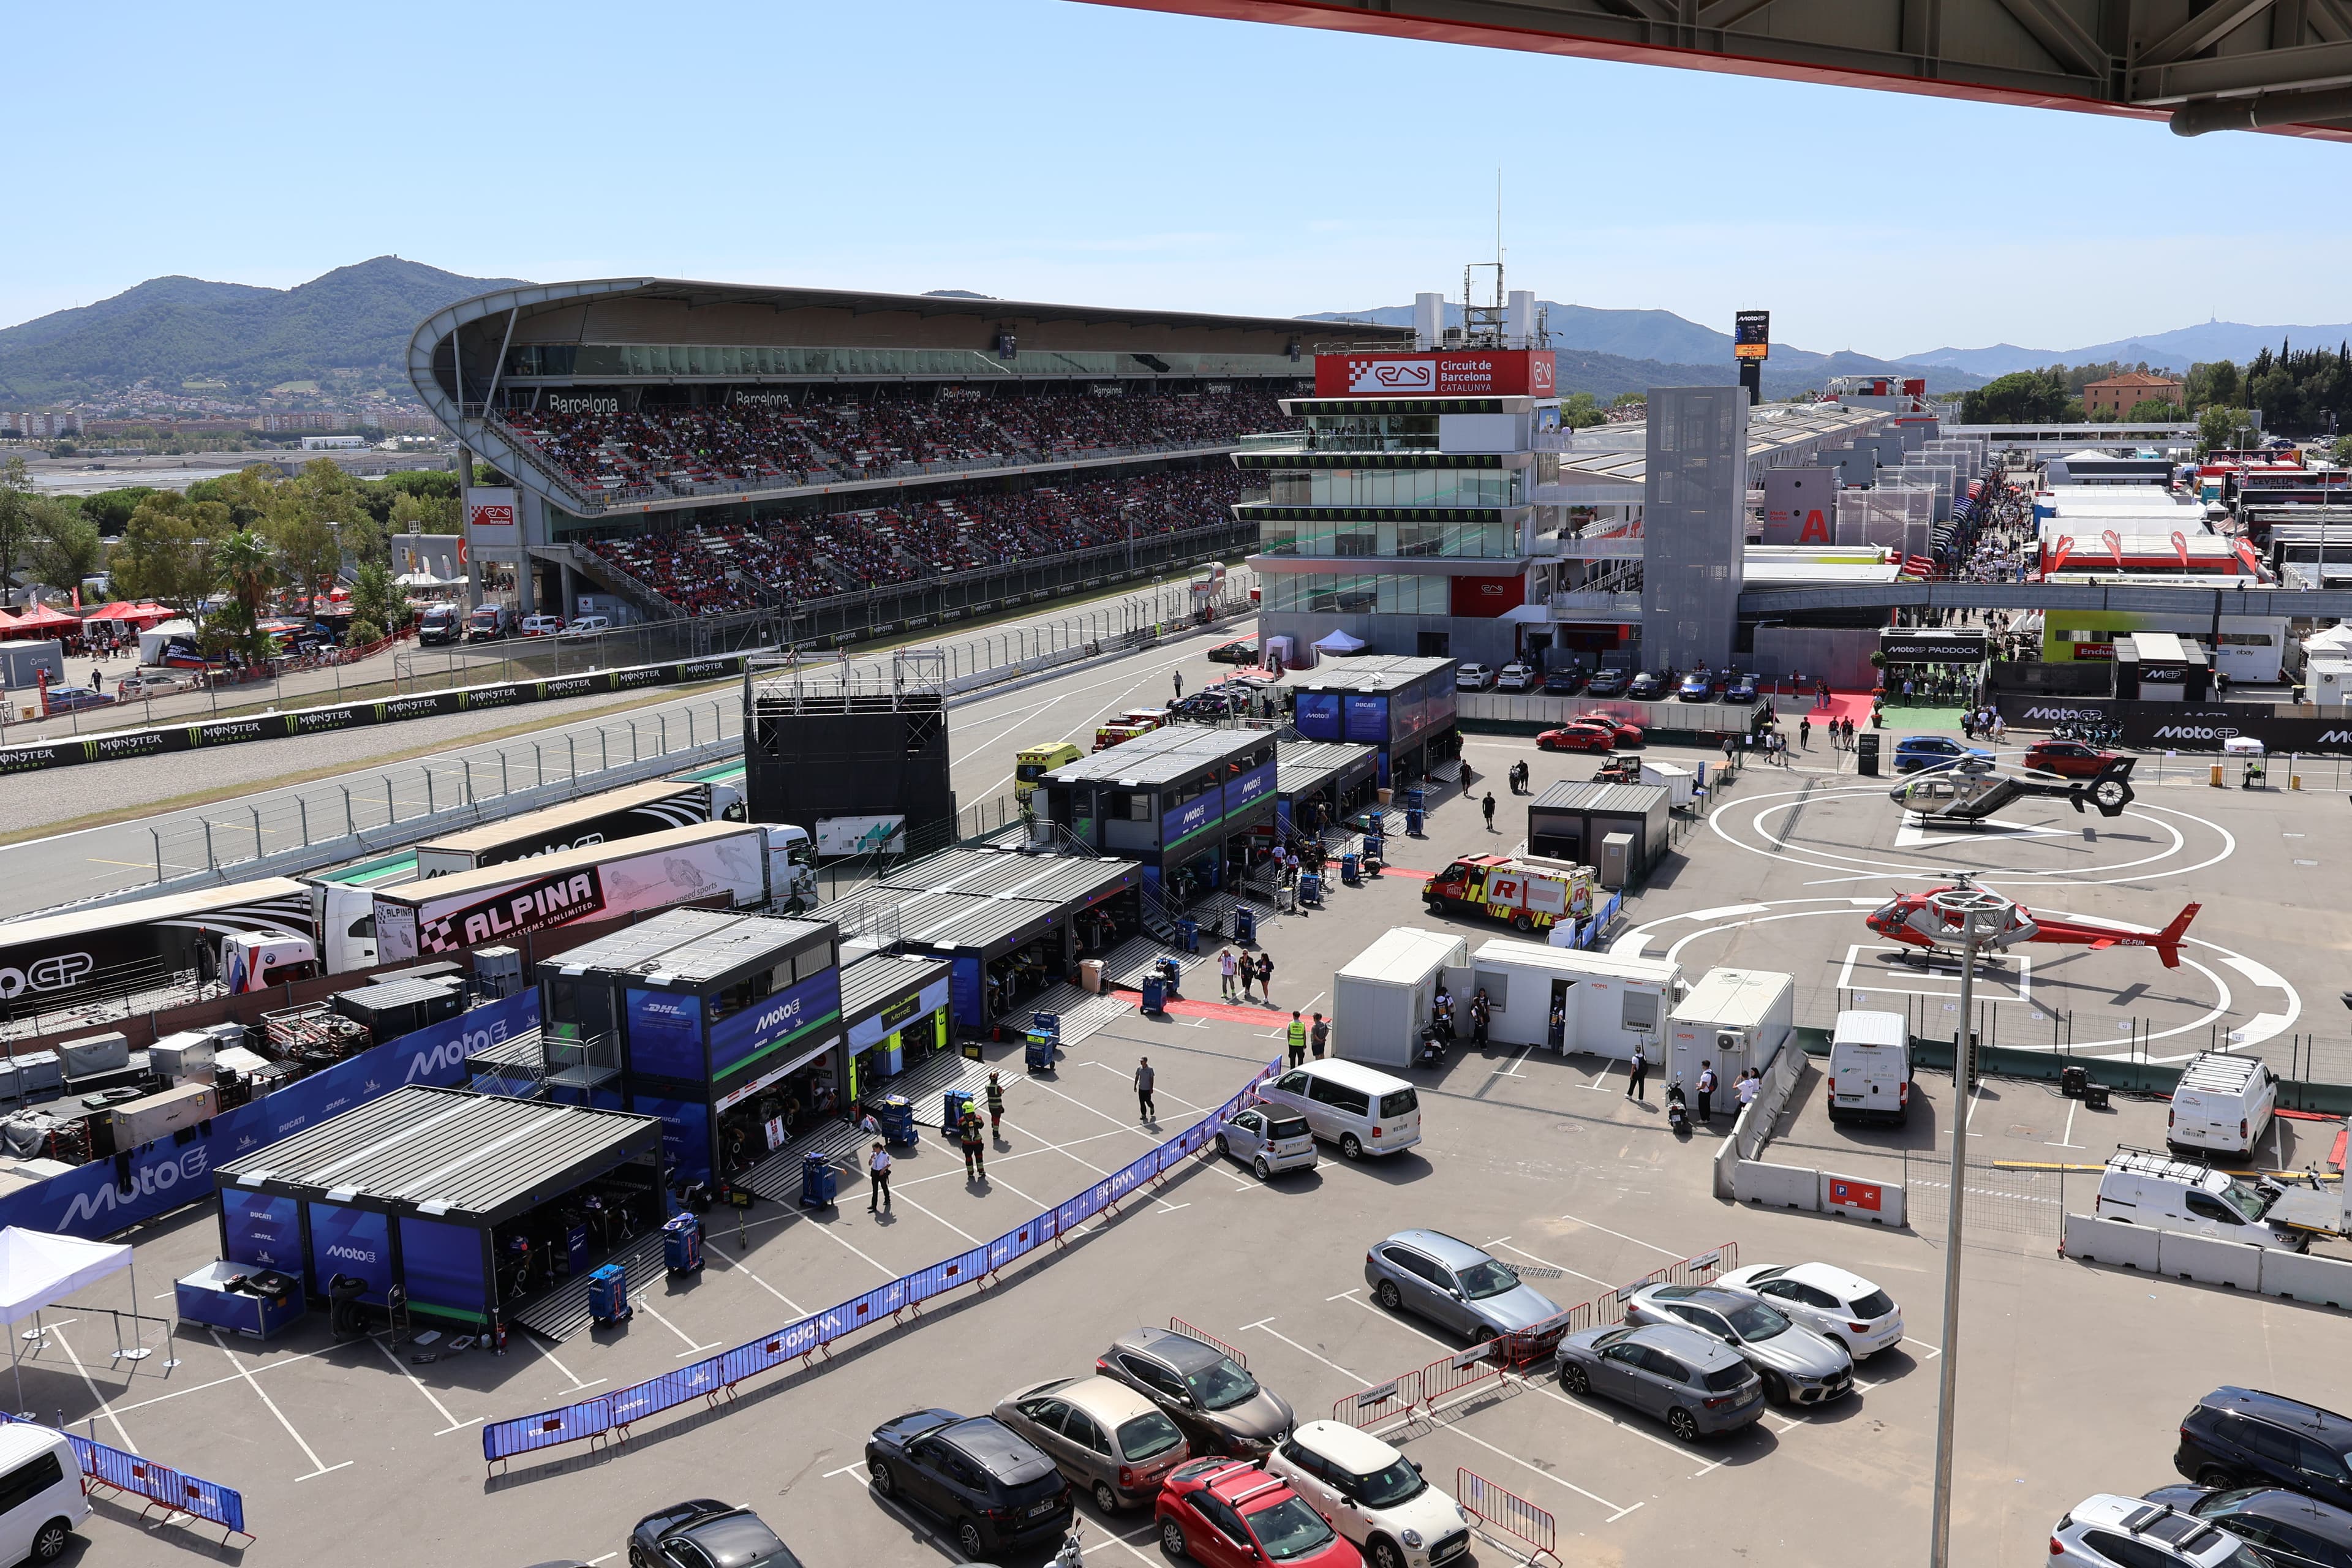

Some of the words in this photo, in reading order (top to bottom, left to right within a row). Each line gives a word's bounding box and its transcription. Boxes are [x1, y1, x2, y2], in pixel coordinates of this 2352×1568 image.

[1441, 361, 1477, 371] Circuit
[1479, 361, 1492, 371] de
[1441, 372, 1492, 382] Barcelona
[1093, 385, 1122, 398] Barcelona
[1441, 383, 1492, 392] CATALUNYA
[549, 393, 618, 414] Barcelona
[736, 391, 789, 407] Barcelona
[1800, 510, 1830, 543] A
[835, 632, 856, 642] MONSTER
[1887, 646, 1926, 655] MotoGP
[1928, 646, 1979, 655] PADDOCK
[686, 662, 723, 673] MONSTER
[620, 669, 660, 682] MONSTER
[548, 679, 591, 692] MONSTER
[554, 688, 585, 697] ENERGY
[470, 688, 516, 702] MONSTER
[387, 698, 437, 713] MONSTER
[478, 698, 510, 707] ENERGY
[301, 710, 352, 725] MONSTER
[396, 709, 431, 718] ENERGY
[203, 722, 261, 739] MONSTER
[309, 722, 345, 731] ENERGY
[2152, 725, 2239, 741] MotoGP
[100, 734, 162, 753] MONSTER
[213, 734, 253, 744] ENERGY
[111, 746, 154, 757] ENERGY
[1515, 870, 1540, 879] BOMBEROS
[696, 881, 718, 897] sports
[1492, 880, 1517, 899] R
[1574, 886, 1585, 902] R
[386, 908, 413, 918] ALPINA
[465, 872, 593, 945] ALPINA
[546, 902, 597, 927] UNLIMITED.
[647, 1003, 680, 1015] DHL
[754, 997, 801, 1034] MotoE
[404, 1019, 507, 1084] MotoE
[279, 1115, 306, 1133] DUCATI
[55, 1145, 208, 1232] MotoE
[250, 1211, 271, 1220] DUCATI
[326, 1245, 377, 1264] MotoE
[1360, 1391, 1379, 1401] DORNA
[1379, 1383, 1395, 1395] GUEST
